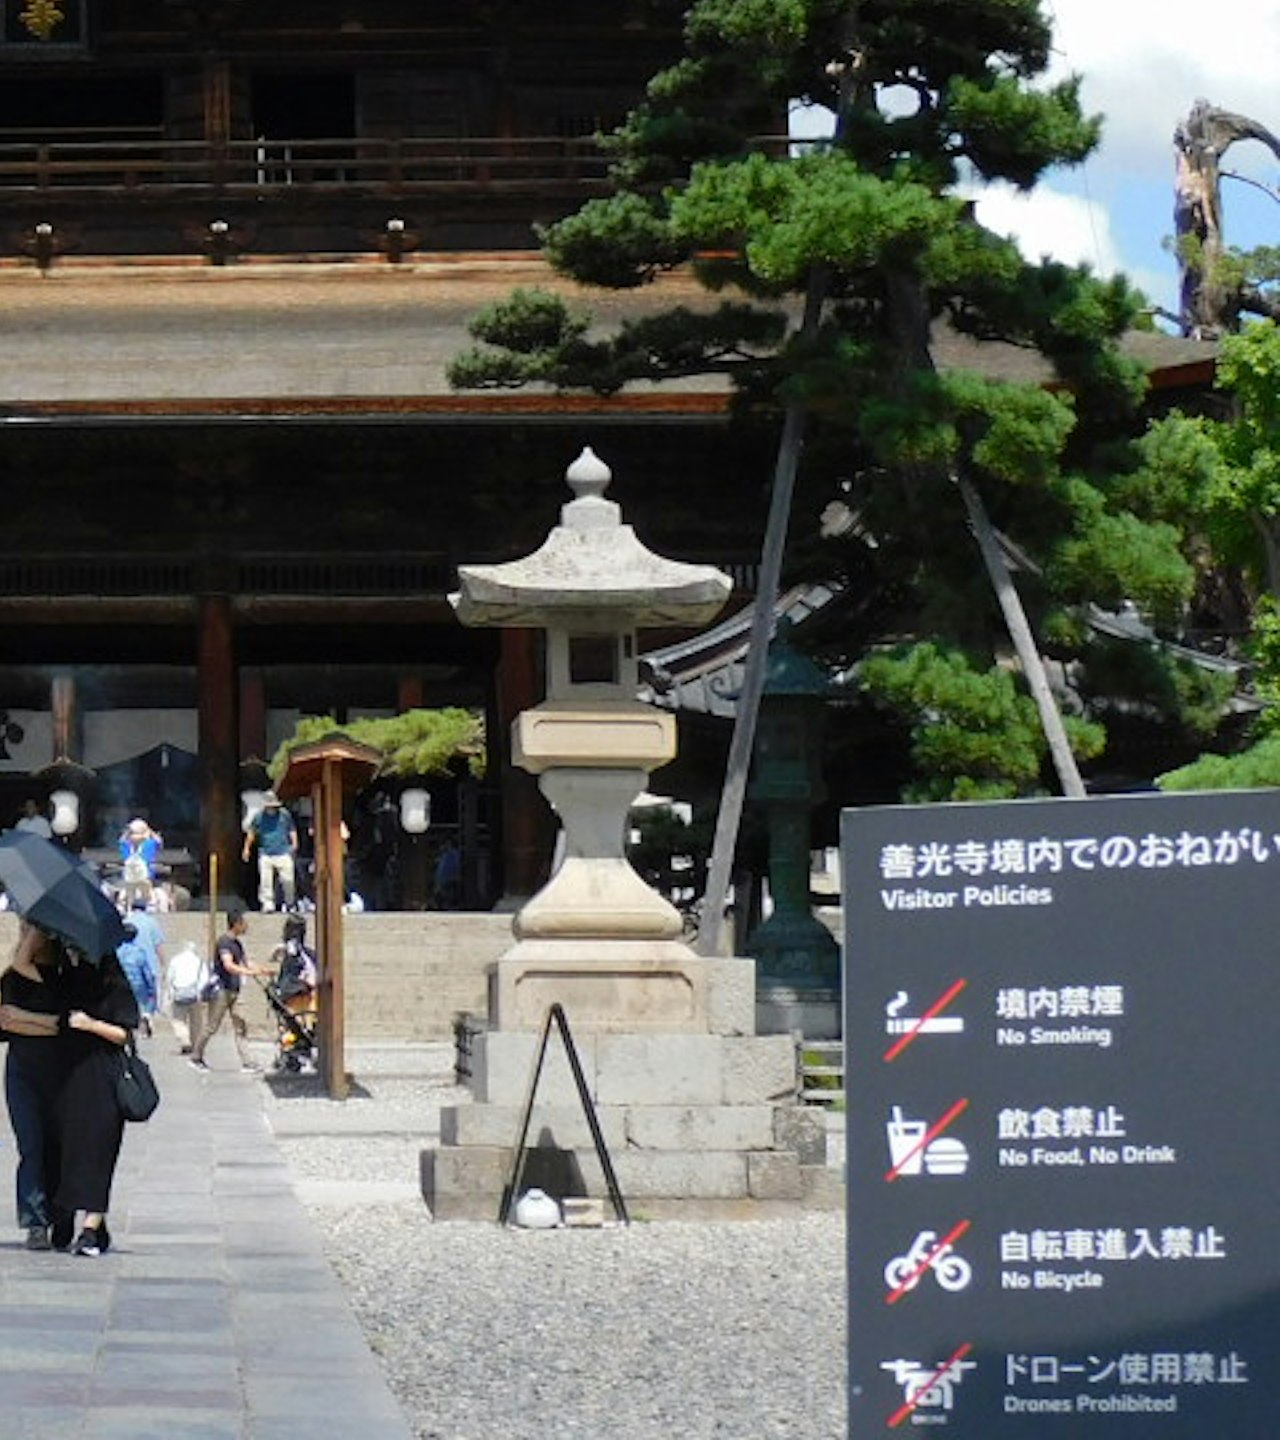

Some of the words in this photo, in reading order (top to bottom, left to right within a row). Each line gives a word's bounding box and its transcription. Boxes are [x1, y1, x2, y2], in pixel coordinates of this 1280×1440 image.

[880, 888, 959, 910] Visitor
[963, 884, 1053, 906] Policies
[996, 985, 1124, 1018] 境内禁煙
[997, 1027, 1027, 1046] No
[1030, 1025, 1112, 1047] Smoking
[998, 1106, 1126, 1140] 飲食禁止
[999, 1148, 1029, 1166] No
[1031, 1147, 1085, 1166] Food,
[1089, 1146, 1119, 1164] No
[1122, 1145, 1175, 1164] Drink
[1000, 1226, 1226, 1262] 自転車進入禁止
[1001, 1271, 1031, 1289] No
[1034, 1269, 1104, 1292] Bicycle
[1006, 1353, 1249, 1386] ドローン使用禁止
[1004, 1395, 1072, 1412] Drones
[1076, 1393, 1177, 1412] Prohibited
